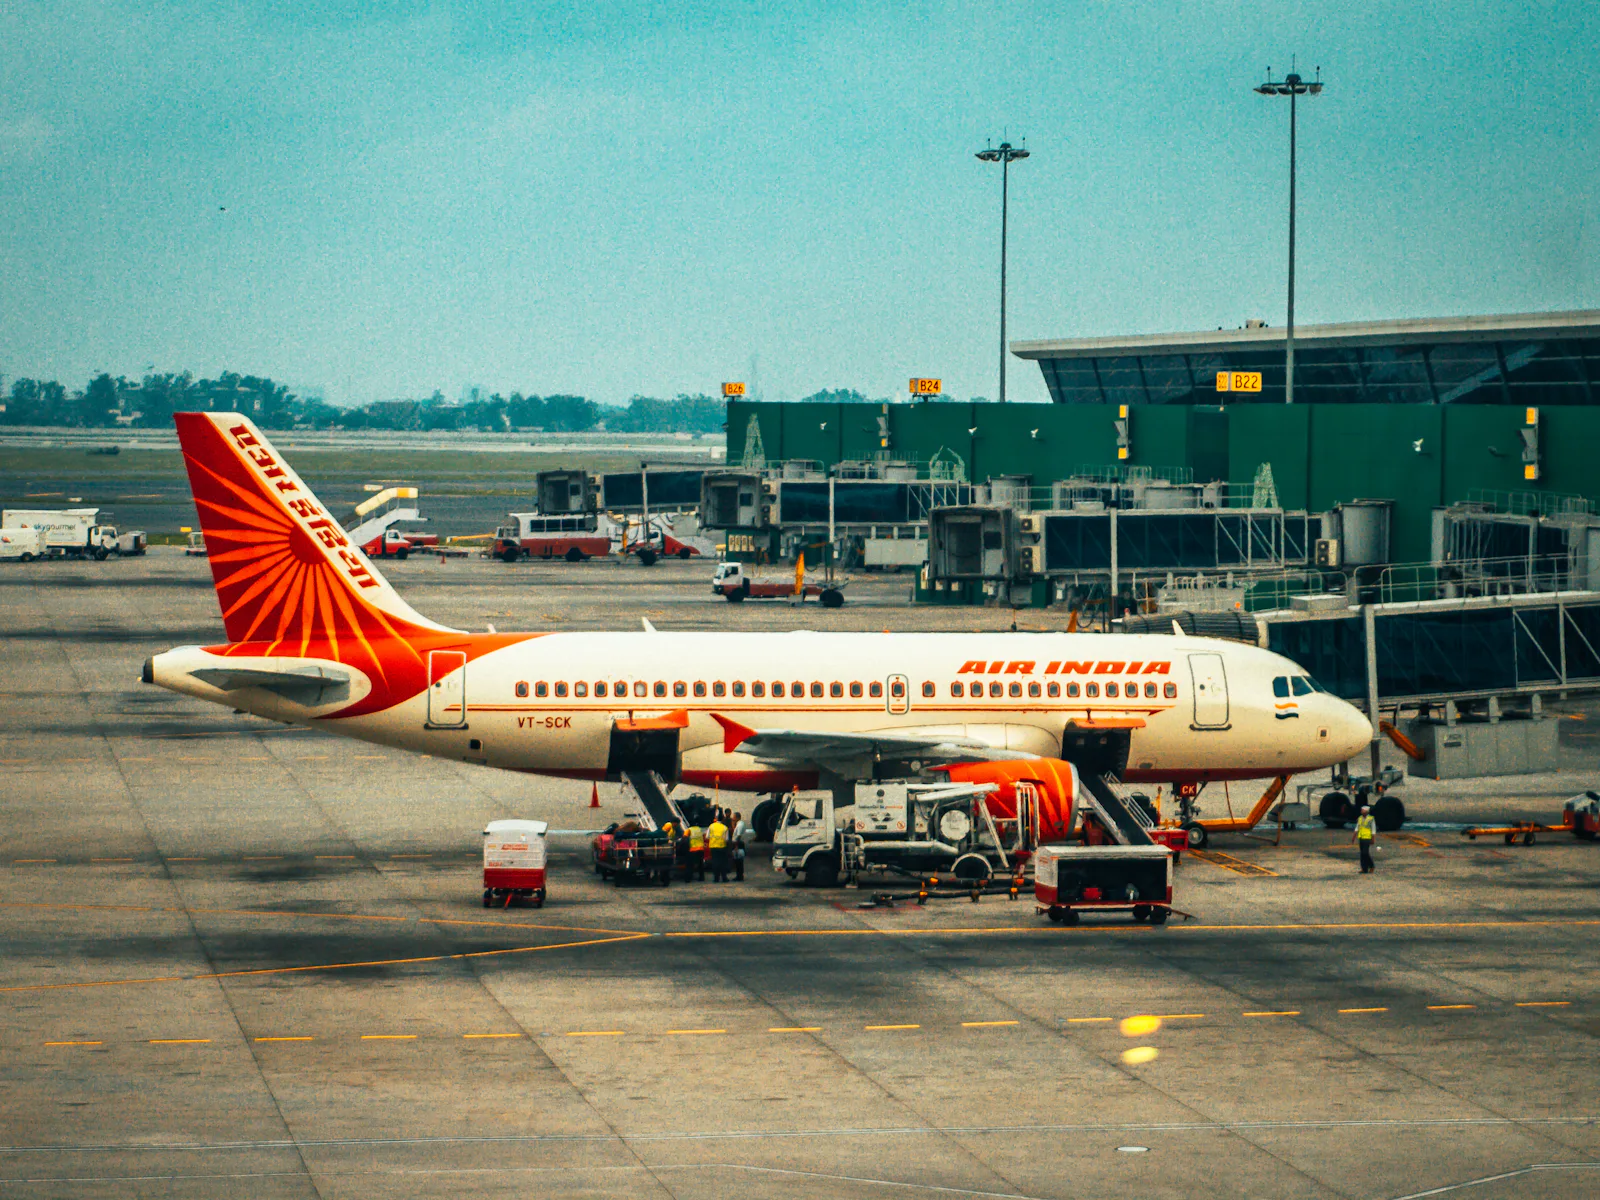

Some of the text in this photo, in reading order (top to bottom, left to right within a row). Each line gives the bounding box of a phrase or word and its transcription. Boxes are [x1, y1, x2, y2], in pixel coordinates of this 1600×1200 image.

[920, 380, 939, 392] B24
[1235, 374, 1259, 389] B22
[727, 383, 744, 394] B26
[956, 660, 1172, 675] AIR INDIA
[517, 716, 572, 729] VT-SCK
[1181, 785, 1195, 795] CK
